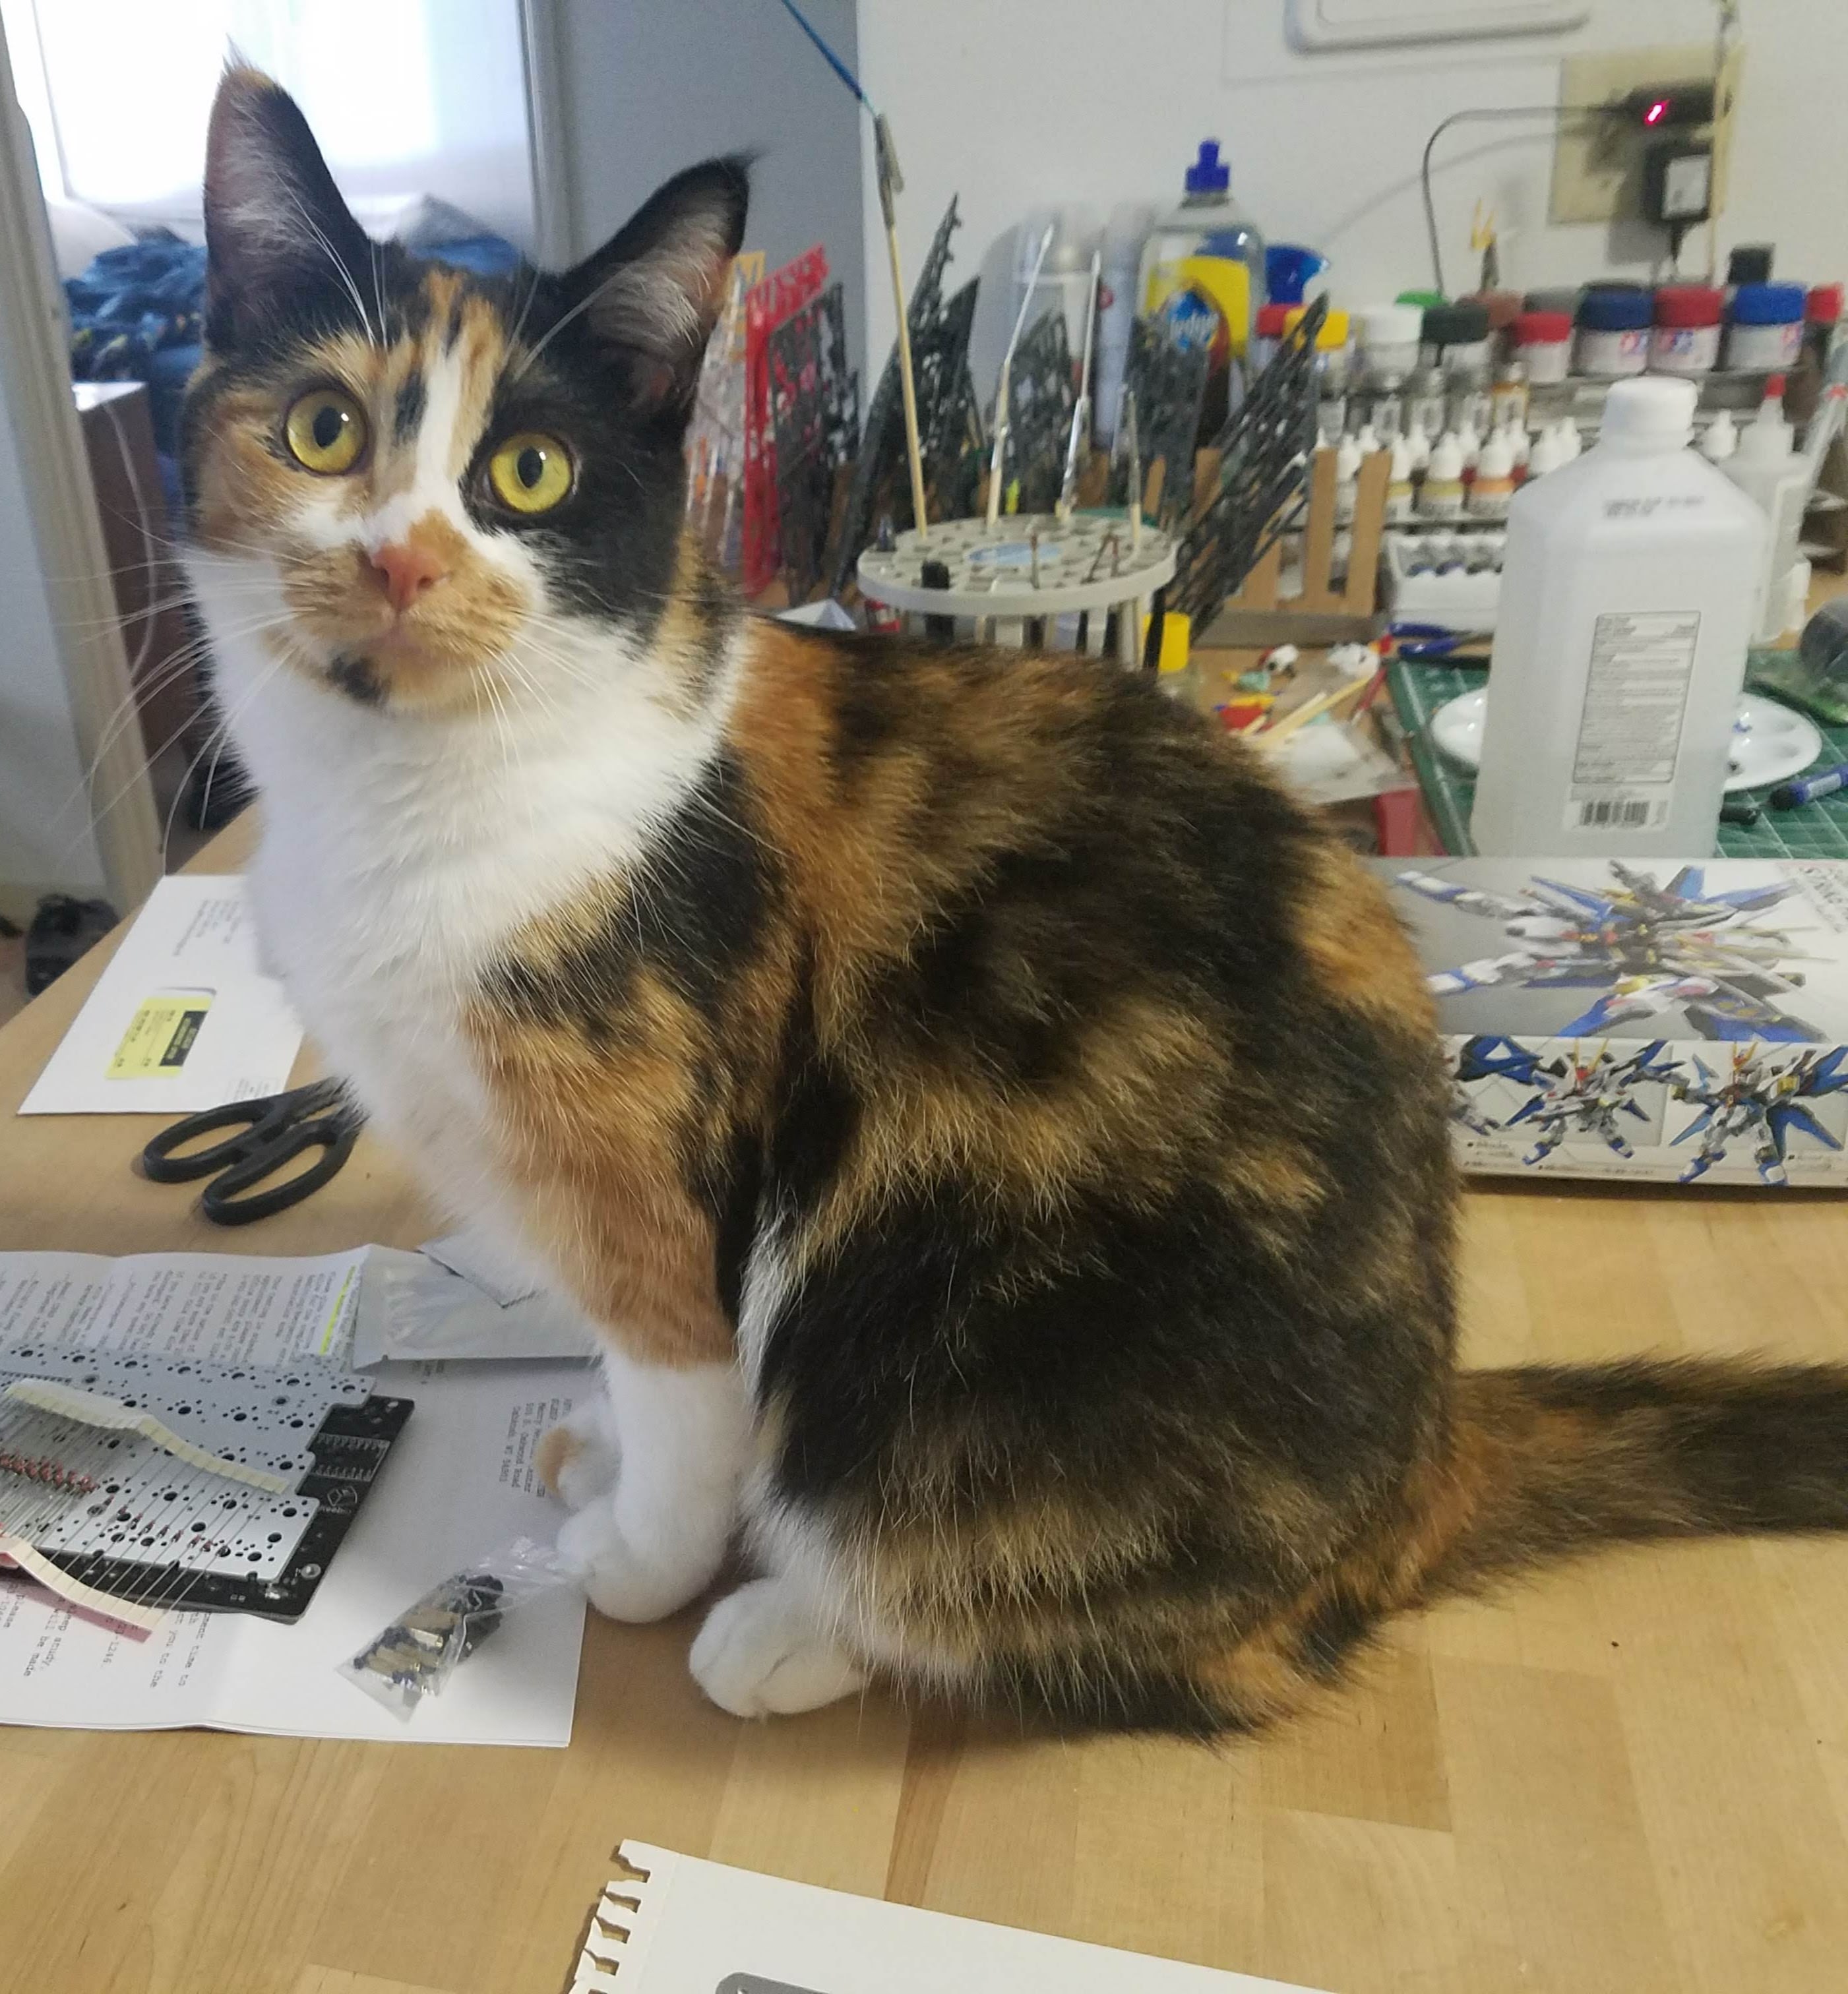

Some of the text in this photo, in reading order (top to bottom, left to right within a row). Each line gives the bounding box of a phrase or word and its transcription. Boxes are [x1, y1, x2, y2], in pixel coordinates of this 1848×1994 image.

[37, 1636, 50, 1647] be
[166, 1630, 178, 1647] you
[23, 1653, 40, 1676] made
[160, 1652, 169, 1664] to
[150, 1670, 164, 1688] the
[178, 1674, 189, 1687] to
